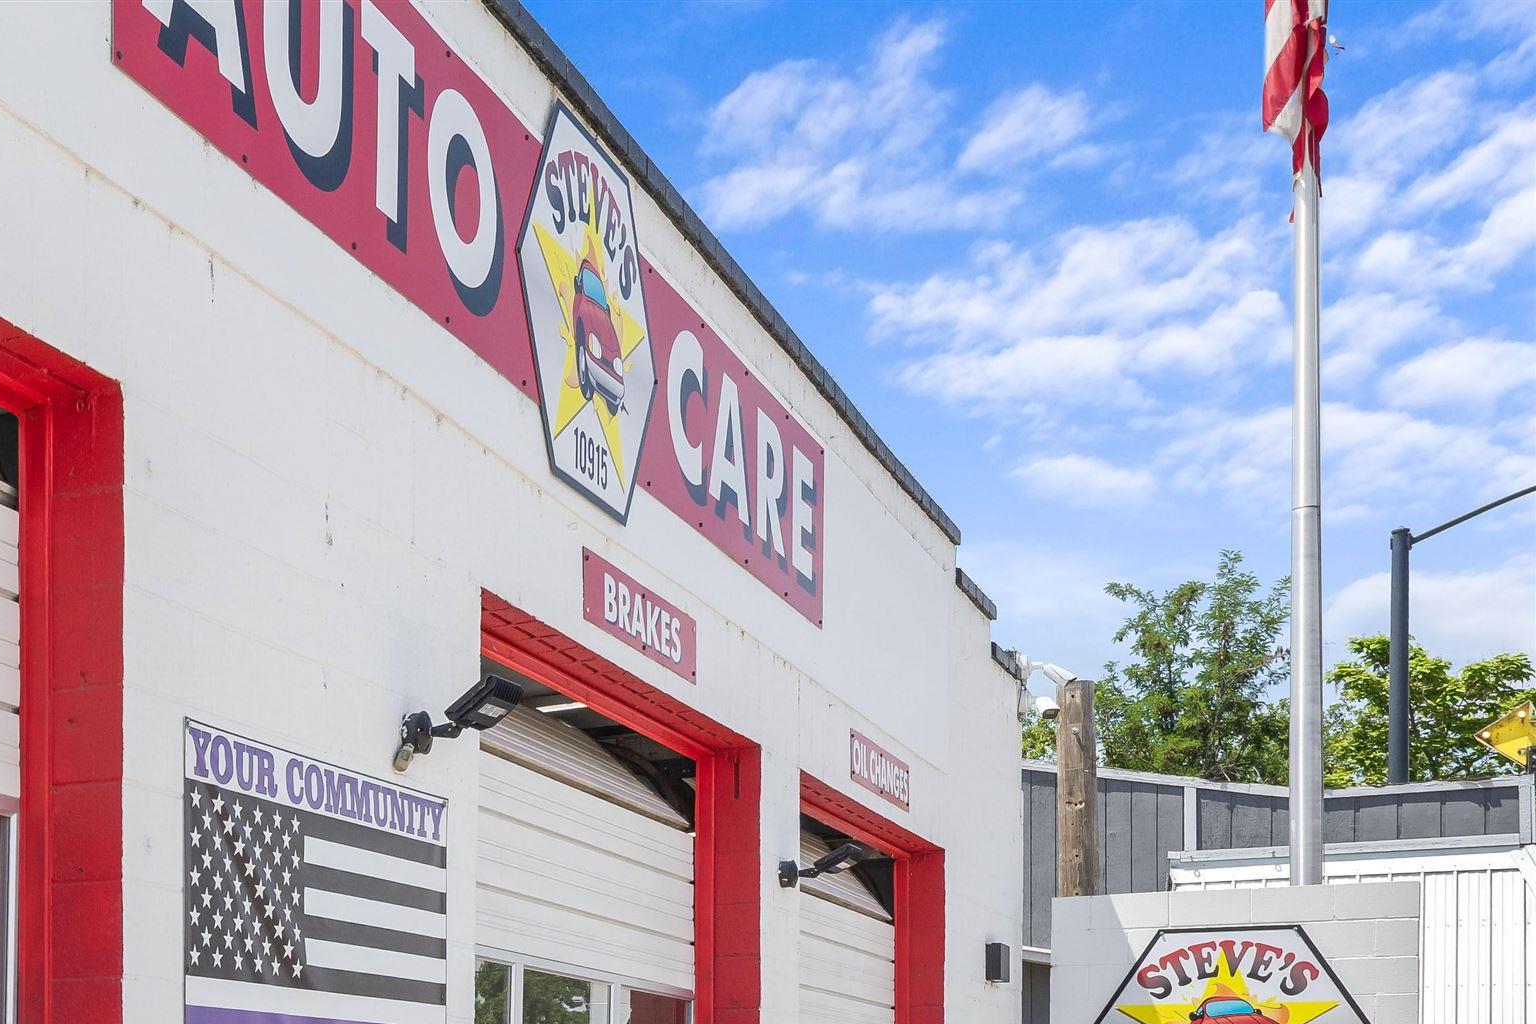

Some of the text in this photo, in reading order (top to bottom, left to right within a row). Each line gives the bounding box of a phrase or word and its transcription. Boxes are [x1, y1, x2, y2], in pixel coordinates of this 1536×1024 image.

[545, 150, 637, 301] STEVE'S
[574, 426, 608, 490] 10915
[667, 330, 815, 582] CARE
[604, 572, 681, 663] BRAKES
[189, 727, 445, 840] YOUR COMMUNITY
[853, 739, 909, 804] OIL CHANGES
[1136, 940, 1320, 1000] STEVE'S
